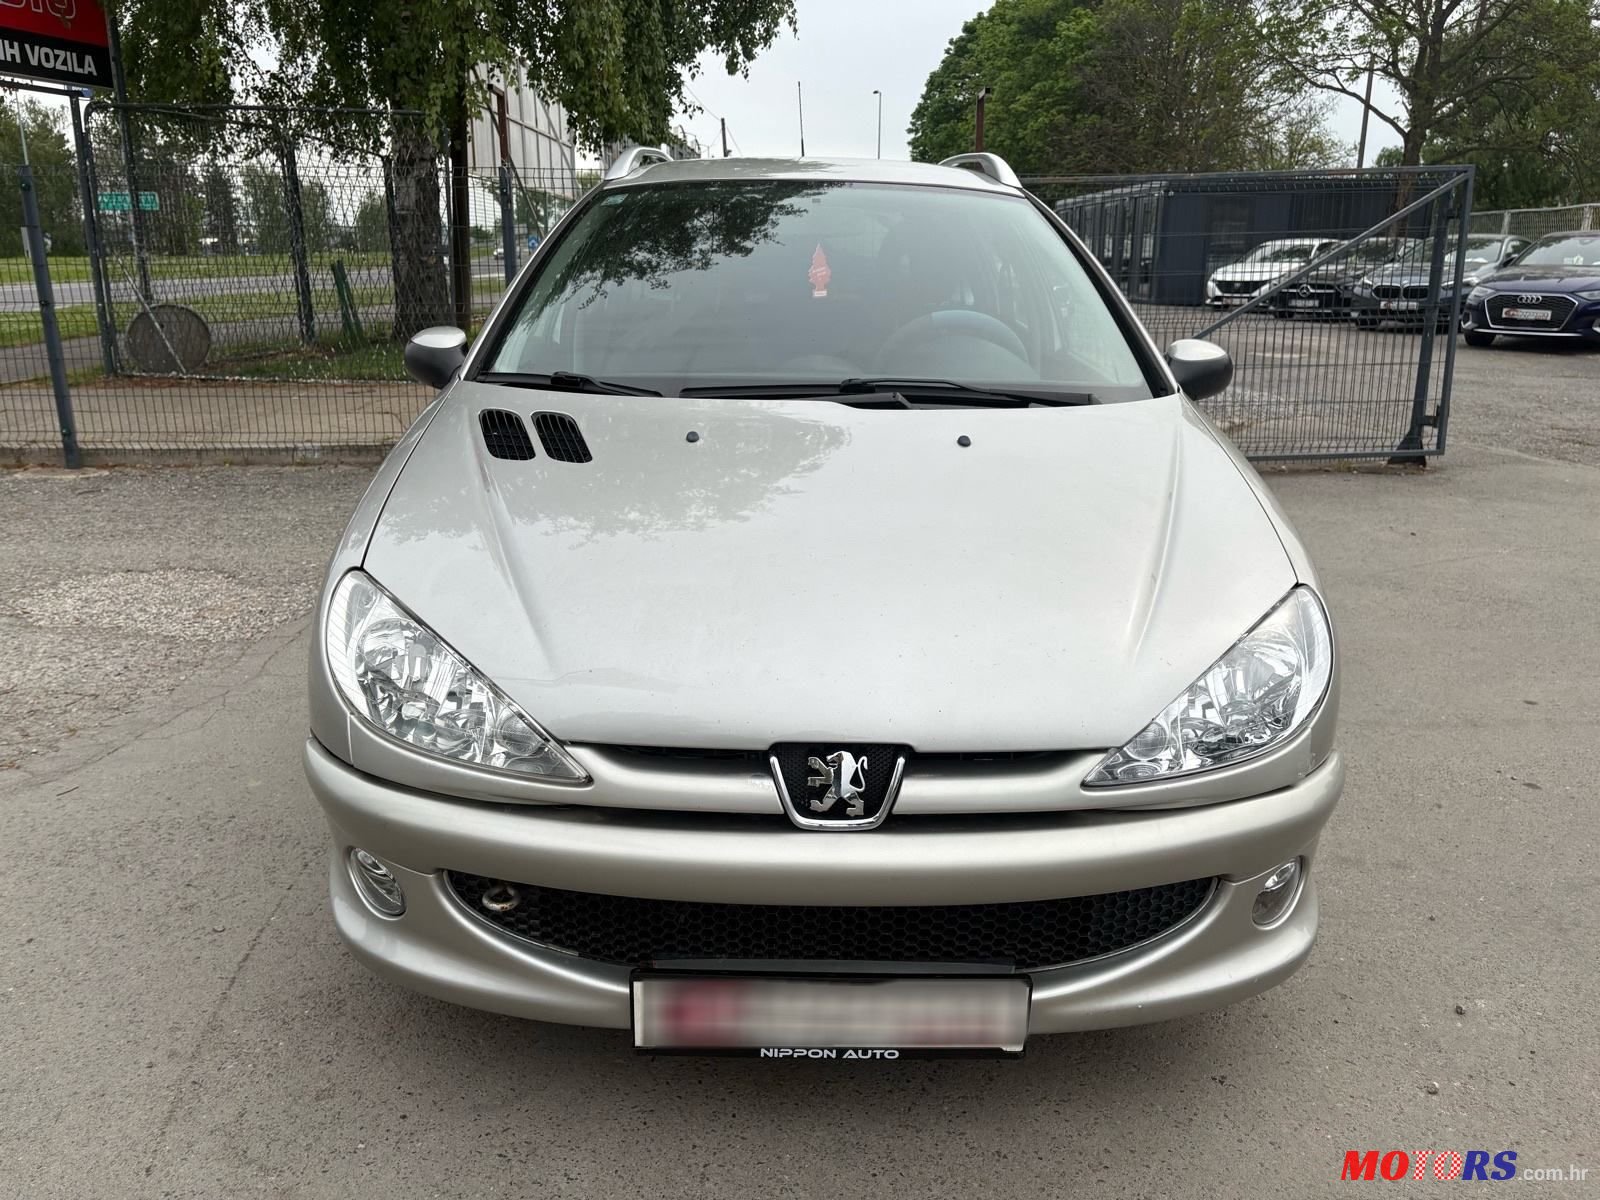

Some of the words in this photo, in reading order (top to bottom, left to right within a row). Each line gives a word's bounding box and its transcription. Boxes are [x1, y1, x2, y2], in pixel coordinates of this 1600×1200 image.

[24, 43, 97, 76] VOZILA
[760, 1047, 837, 1059] NIPPON
[842, 1049, 900, 1060] AUTO
